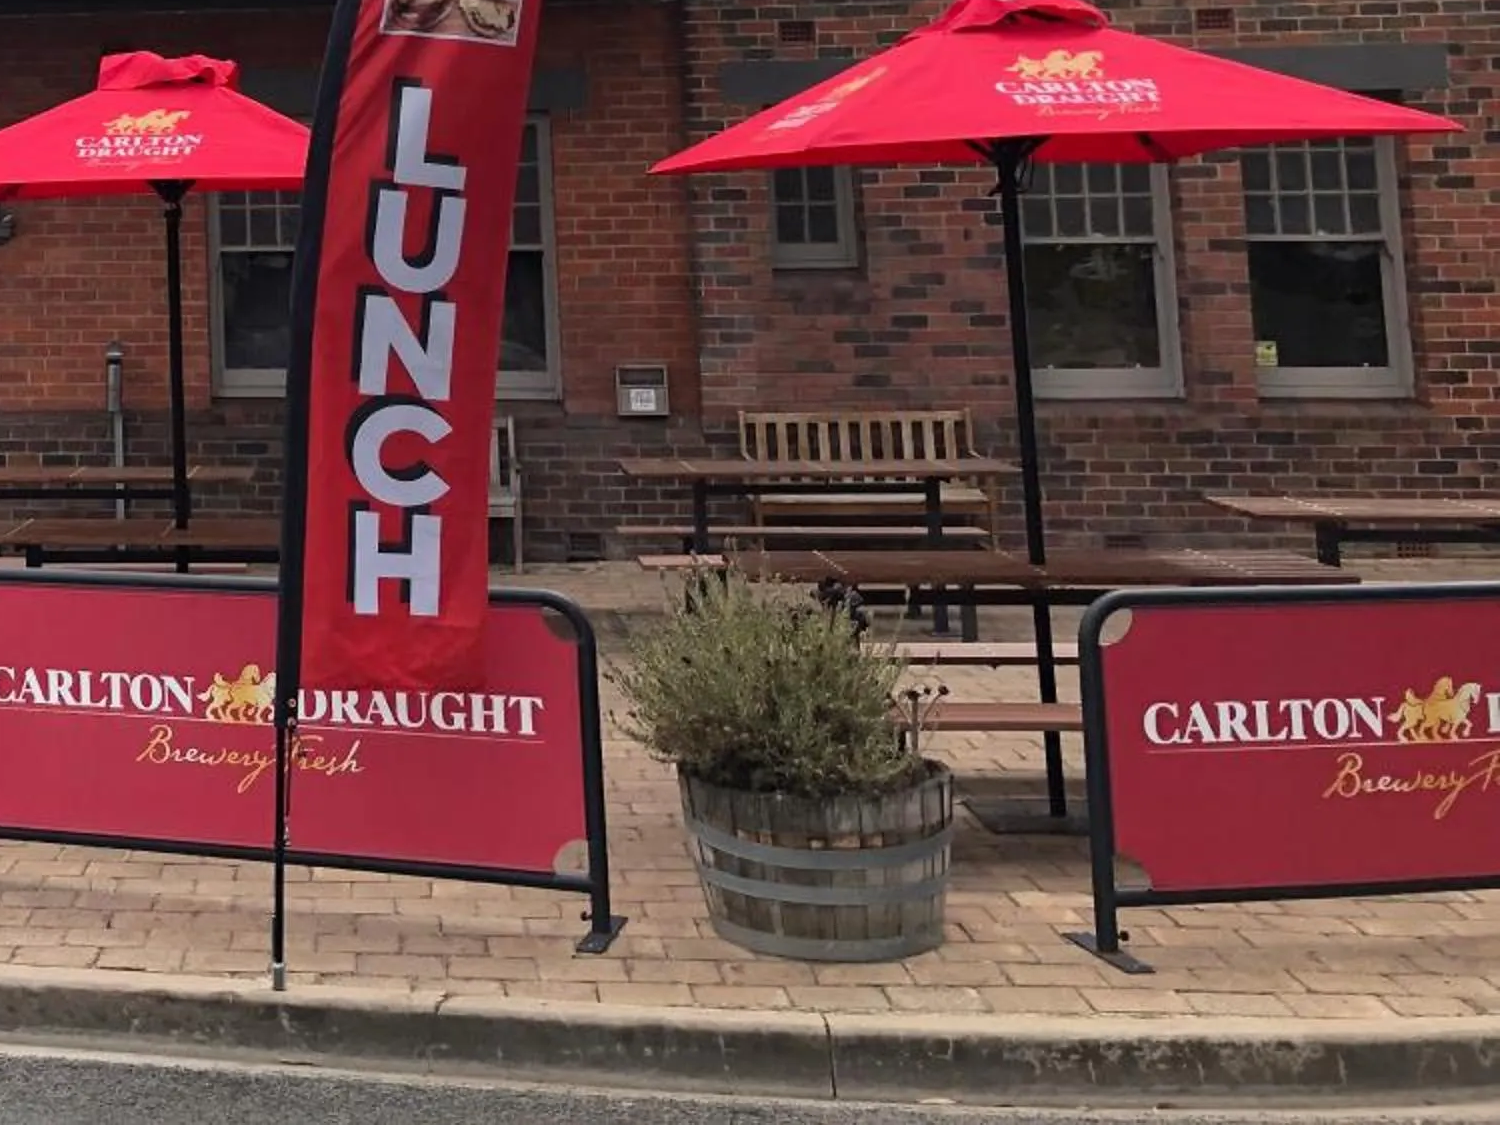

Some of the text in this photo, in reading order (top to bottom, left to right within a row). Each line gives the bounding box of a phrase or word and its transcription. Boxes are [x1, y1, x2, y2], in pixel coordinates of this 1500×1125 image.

[995, 79, 1158, 94] CARLTON
[75, 133, 203, 148] CARLTON
[76, 144, 197, 158] DRAUGHT
[348, 82, 468, 618] LUNCH
[296, 687, 545, 736] DRAUGHT
[1143, 696, 1387, 745] CARLTON
[136, 724, 277, 794] Brewery
[1321, 751, 1476, 820] Brewery
